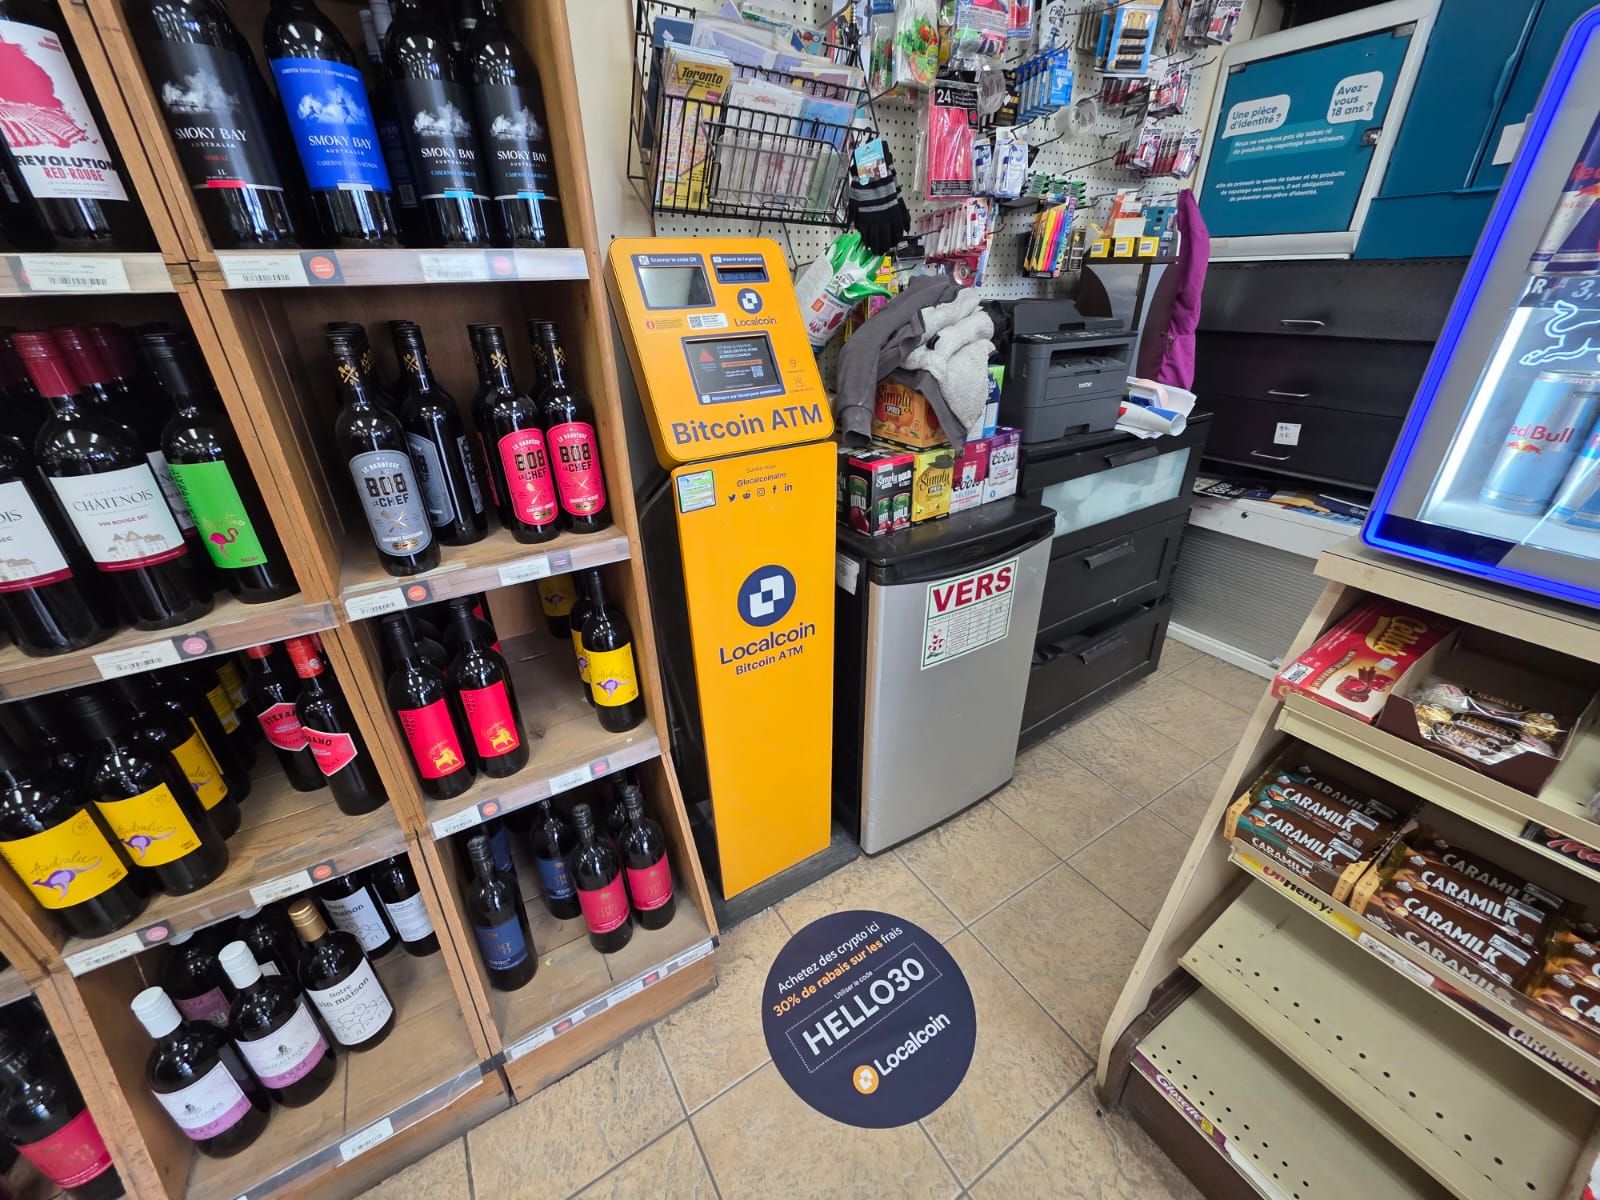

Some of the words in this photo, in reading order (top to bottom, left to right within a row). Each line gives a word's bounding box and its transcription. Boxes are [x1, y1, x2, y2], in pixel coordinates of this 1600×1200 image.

[682, 66, 724, 85] Toronto
[936, 88, 952, 104] 24
[1336, 84, 1369, 96] Avez-
[1331, 106, 1343, 117] 18
[1344, 105, 1364, 116] ans
[1333, 95, 1359, 107] vous
[1229, 114, 1275, 130] d'identité
[1231, 110, 1250, 121] Une
[1251, 105, 1278, 121] pièce
[174, 126, 216, 140] SMOKY
[219, 127, 247, 142] BAY
[308, 134, 349, 147] SMOKY
[351, 137, 372, 150] BAY
[420, 147, 456, 159] SMOKY
[458, 148, 475, 161] BAY
[496, 149, 530, 161] SMOKY
[532, 151, 548, 163] BAY
[733, 316, 777, 327] Localcoin
[671, 413, 765, 445] Bitcoin
[771, 403, 823, 431] ATM
[1530, 424, 1575, 444] Bull
[514, 448, 546, 472] BOB
[558, 442, 592, 464] BOB
[991, 450, 1017, 466] Coors
[525, 466, 548, 481] CHEF
[568, 460, 593, 473] CHEF
[364, 472, 408, 498] BOB
[784, 483, 793, 492] in
[875, 471, 899, 488] Simply
[919, 469, 951, 491] Simply
[952, 478, 982, 492] Coors
[379, 492, 409, 508] CHEF
[112, 516, 138, 526] ROUGE
[138, 513, 151, 522] SEC
[878, 512, 889, 525] BOL
[932, 566, 1012, 613] VERS
[719, 622, 816, 666] Localcoin
[735, 654, 777, 675] Bitcoin
[778, 644, 804, 662] ATM
[1281, 787, 1358, 832] CARAMILK
[1263, 813, 1339, 862] CARAMILK
[1251, 837, 1311, 877] CARAMILK
[1442, 853, 1538, 905] CARAMILK
[1420, 870, 1521, 927] CARAMILK
[1403, 897, 1503, 965] CARAMILK
[777, 961, 820, 995] Achetez
[817, 951, 838, 968] des
[836, 930, 869, 957] crypto
[866, 920, 881, 935] ici
[1404, 931, 1517, 1003] CARAMILK
[772, 993, 801, 1018] 30%
[800, 985, 817, 999] de
[816, 961, 851, 989] rabais
[849, 951, 868, 967] sur
[864, 939, 884, 956] les
[880, 926, 904, 945] frais
[329, 984, 352, 999] Notre
[334, 976, 369, 1006] maison
[832, 980, 856, 1001] Utiliser
[858, 969, 874, 983] code
[802, 957, 925, 1057] HELLO30
[873, 1012, 952, 1077] Localcoin
[1155, 1073, 1203, 1122] Glosette
